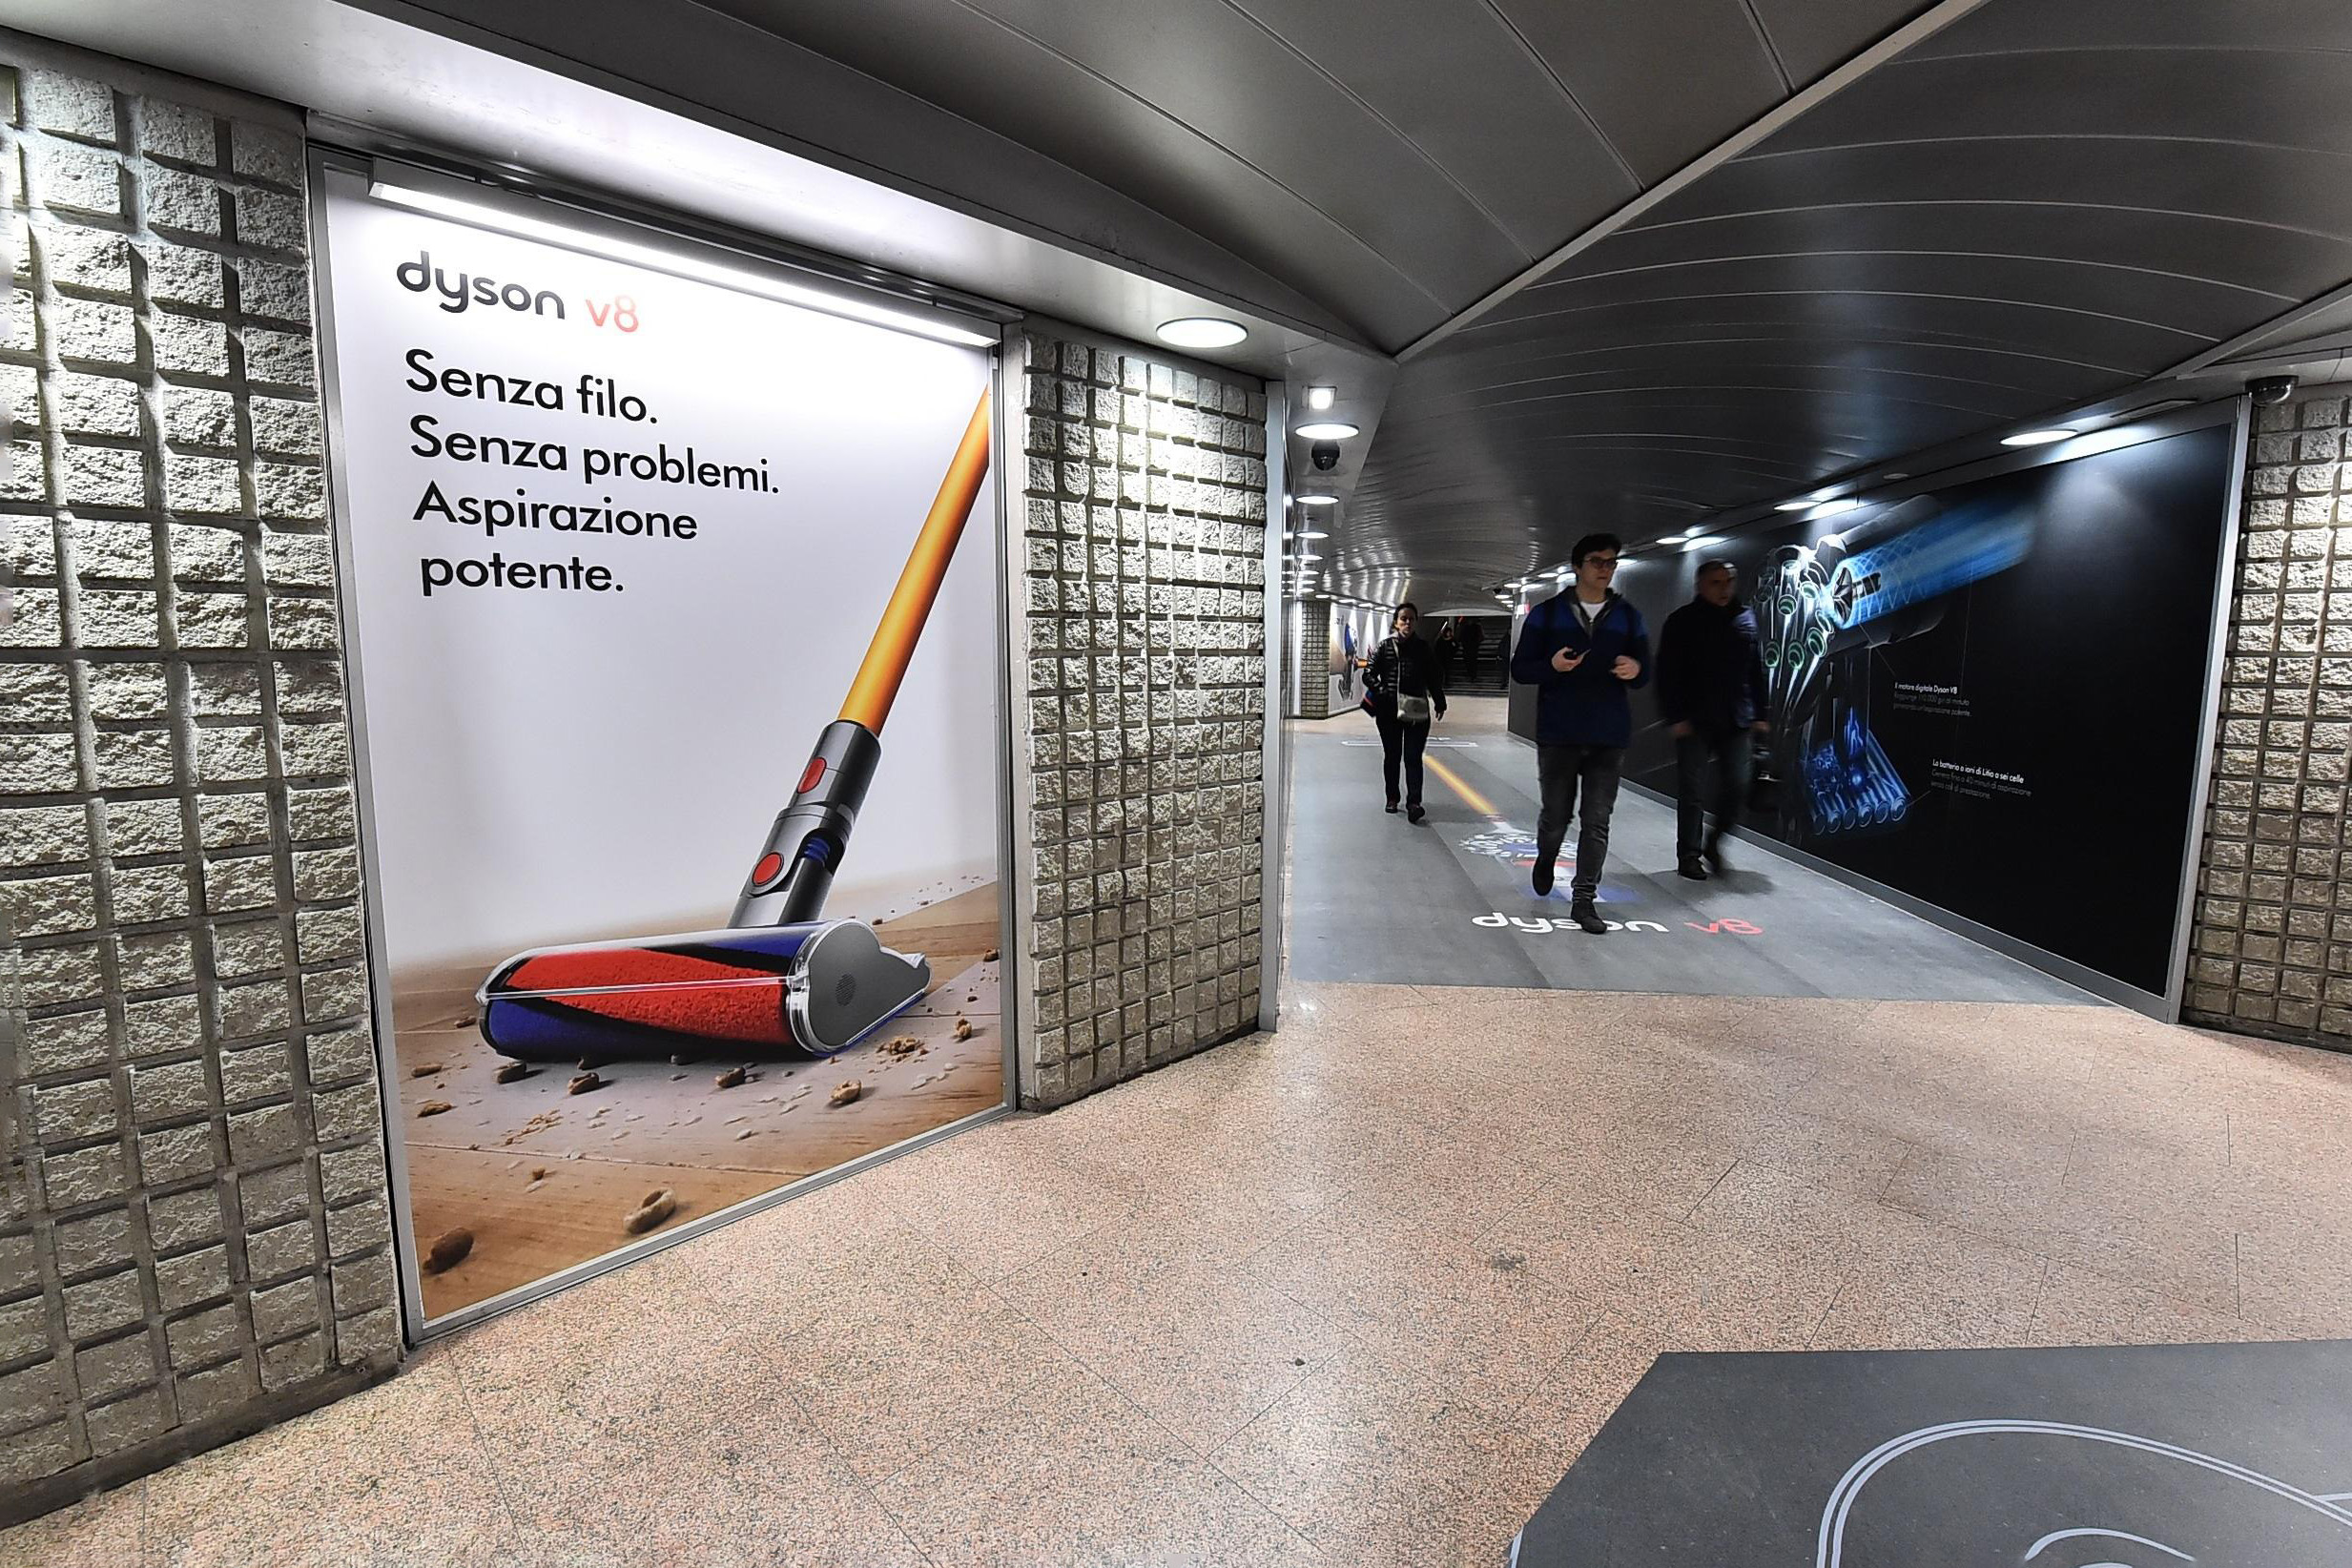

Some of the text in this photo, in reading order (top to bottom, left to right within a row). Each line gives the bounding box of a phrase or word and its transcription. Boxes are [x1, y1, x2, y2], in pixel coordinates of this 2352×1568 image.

[396, 250, 639, 333] dyson v8
[404, 348, 658, 423] Senza filo.
[409, 414, 780, 493] Senza problemi.
[412, 479, 698, 540] Aspirazione
[421, 552, 625, 596] potente.
[1934, 685, 1950, 694] Dyson
[1932, 758, 1938, 767] La
[1965, 764, 1975, 774] ioni
[1975, 766, 1981, 775] di
[2000, 772, 2009, 780] sei
